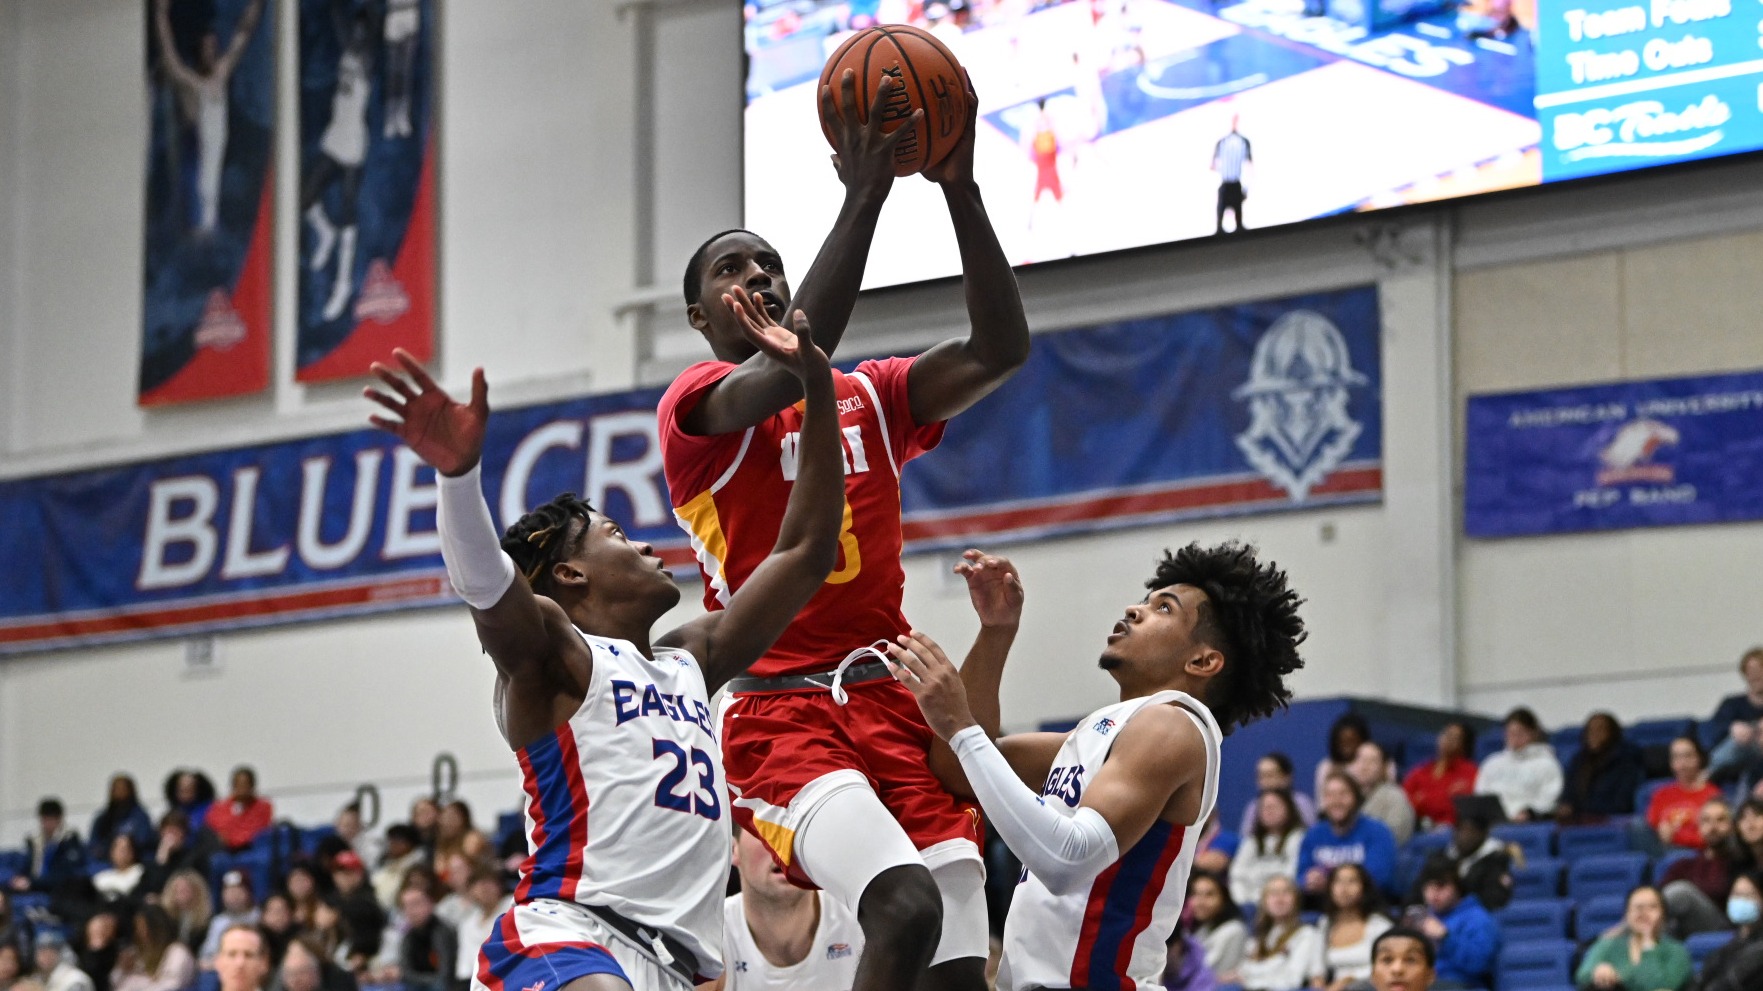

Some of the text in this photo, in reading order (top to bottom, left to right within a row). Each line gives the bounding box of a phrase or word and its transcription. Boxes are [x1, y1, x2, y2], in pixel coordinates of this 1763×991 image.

[134, 410, 668, 590] BLUE CR
[652, 737, 721, 821] 23
[1040, 764, 1085, 807] GLES
